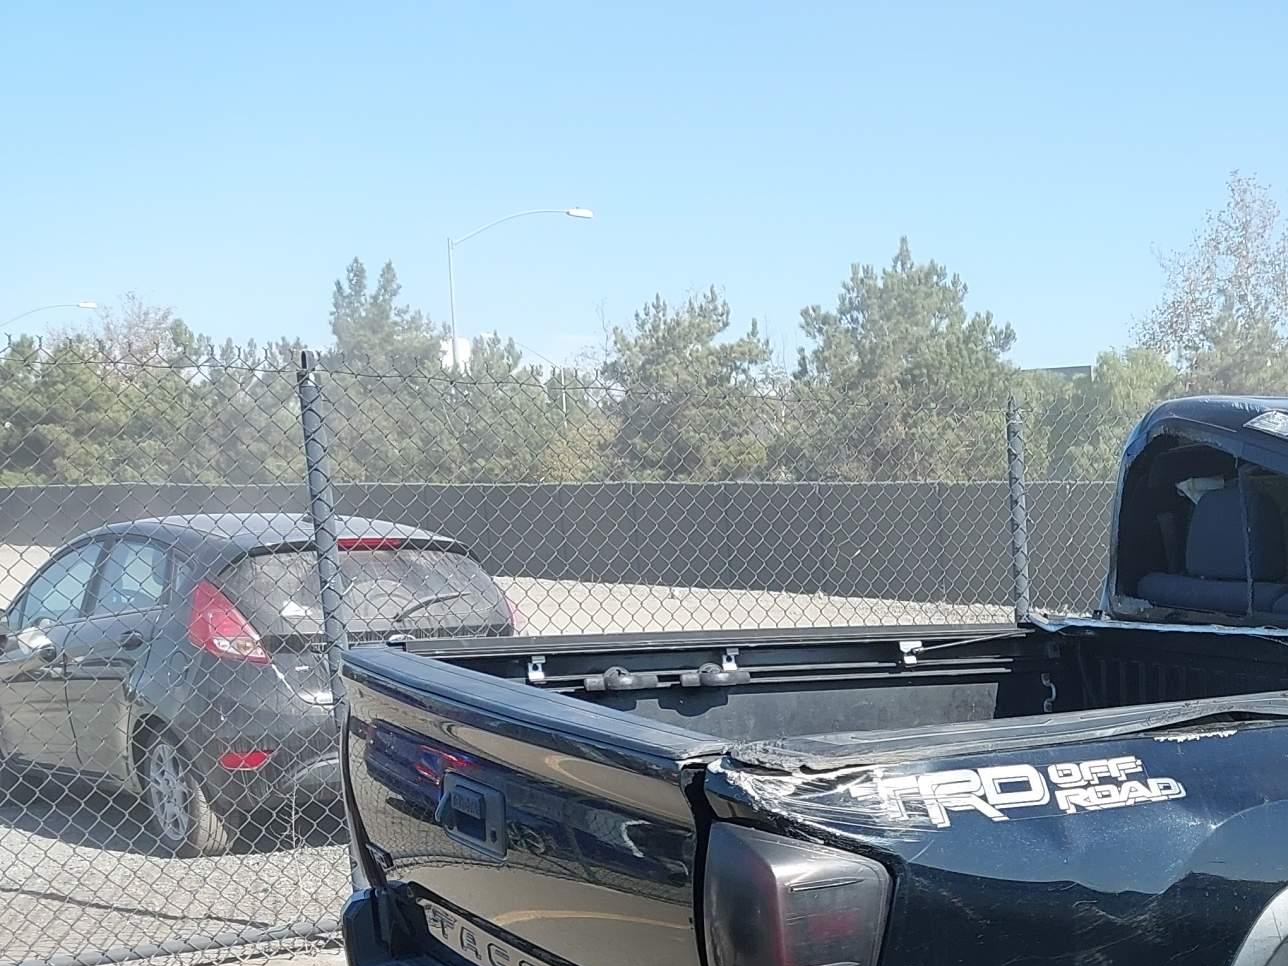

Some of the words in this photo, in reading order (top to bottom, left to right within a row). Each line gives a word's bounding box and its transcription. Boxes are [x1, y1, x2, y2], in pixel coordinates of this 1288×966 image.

[1047, 756, 1143, 786] OFF
[851, 763, 1050, 828] TRD
[1055, 777, 1187, 814] ROAD
